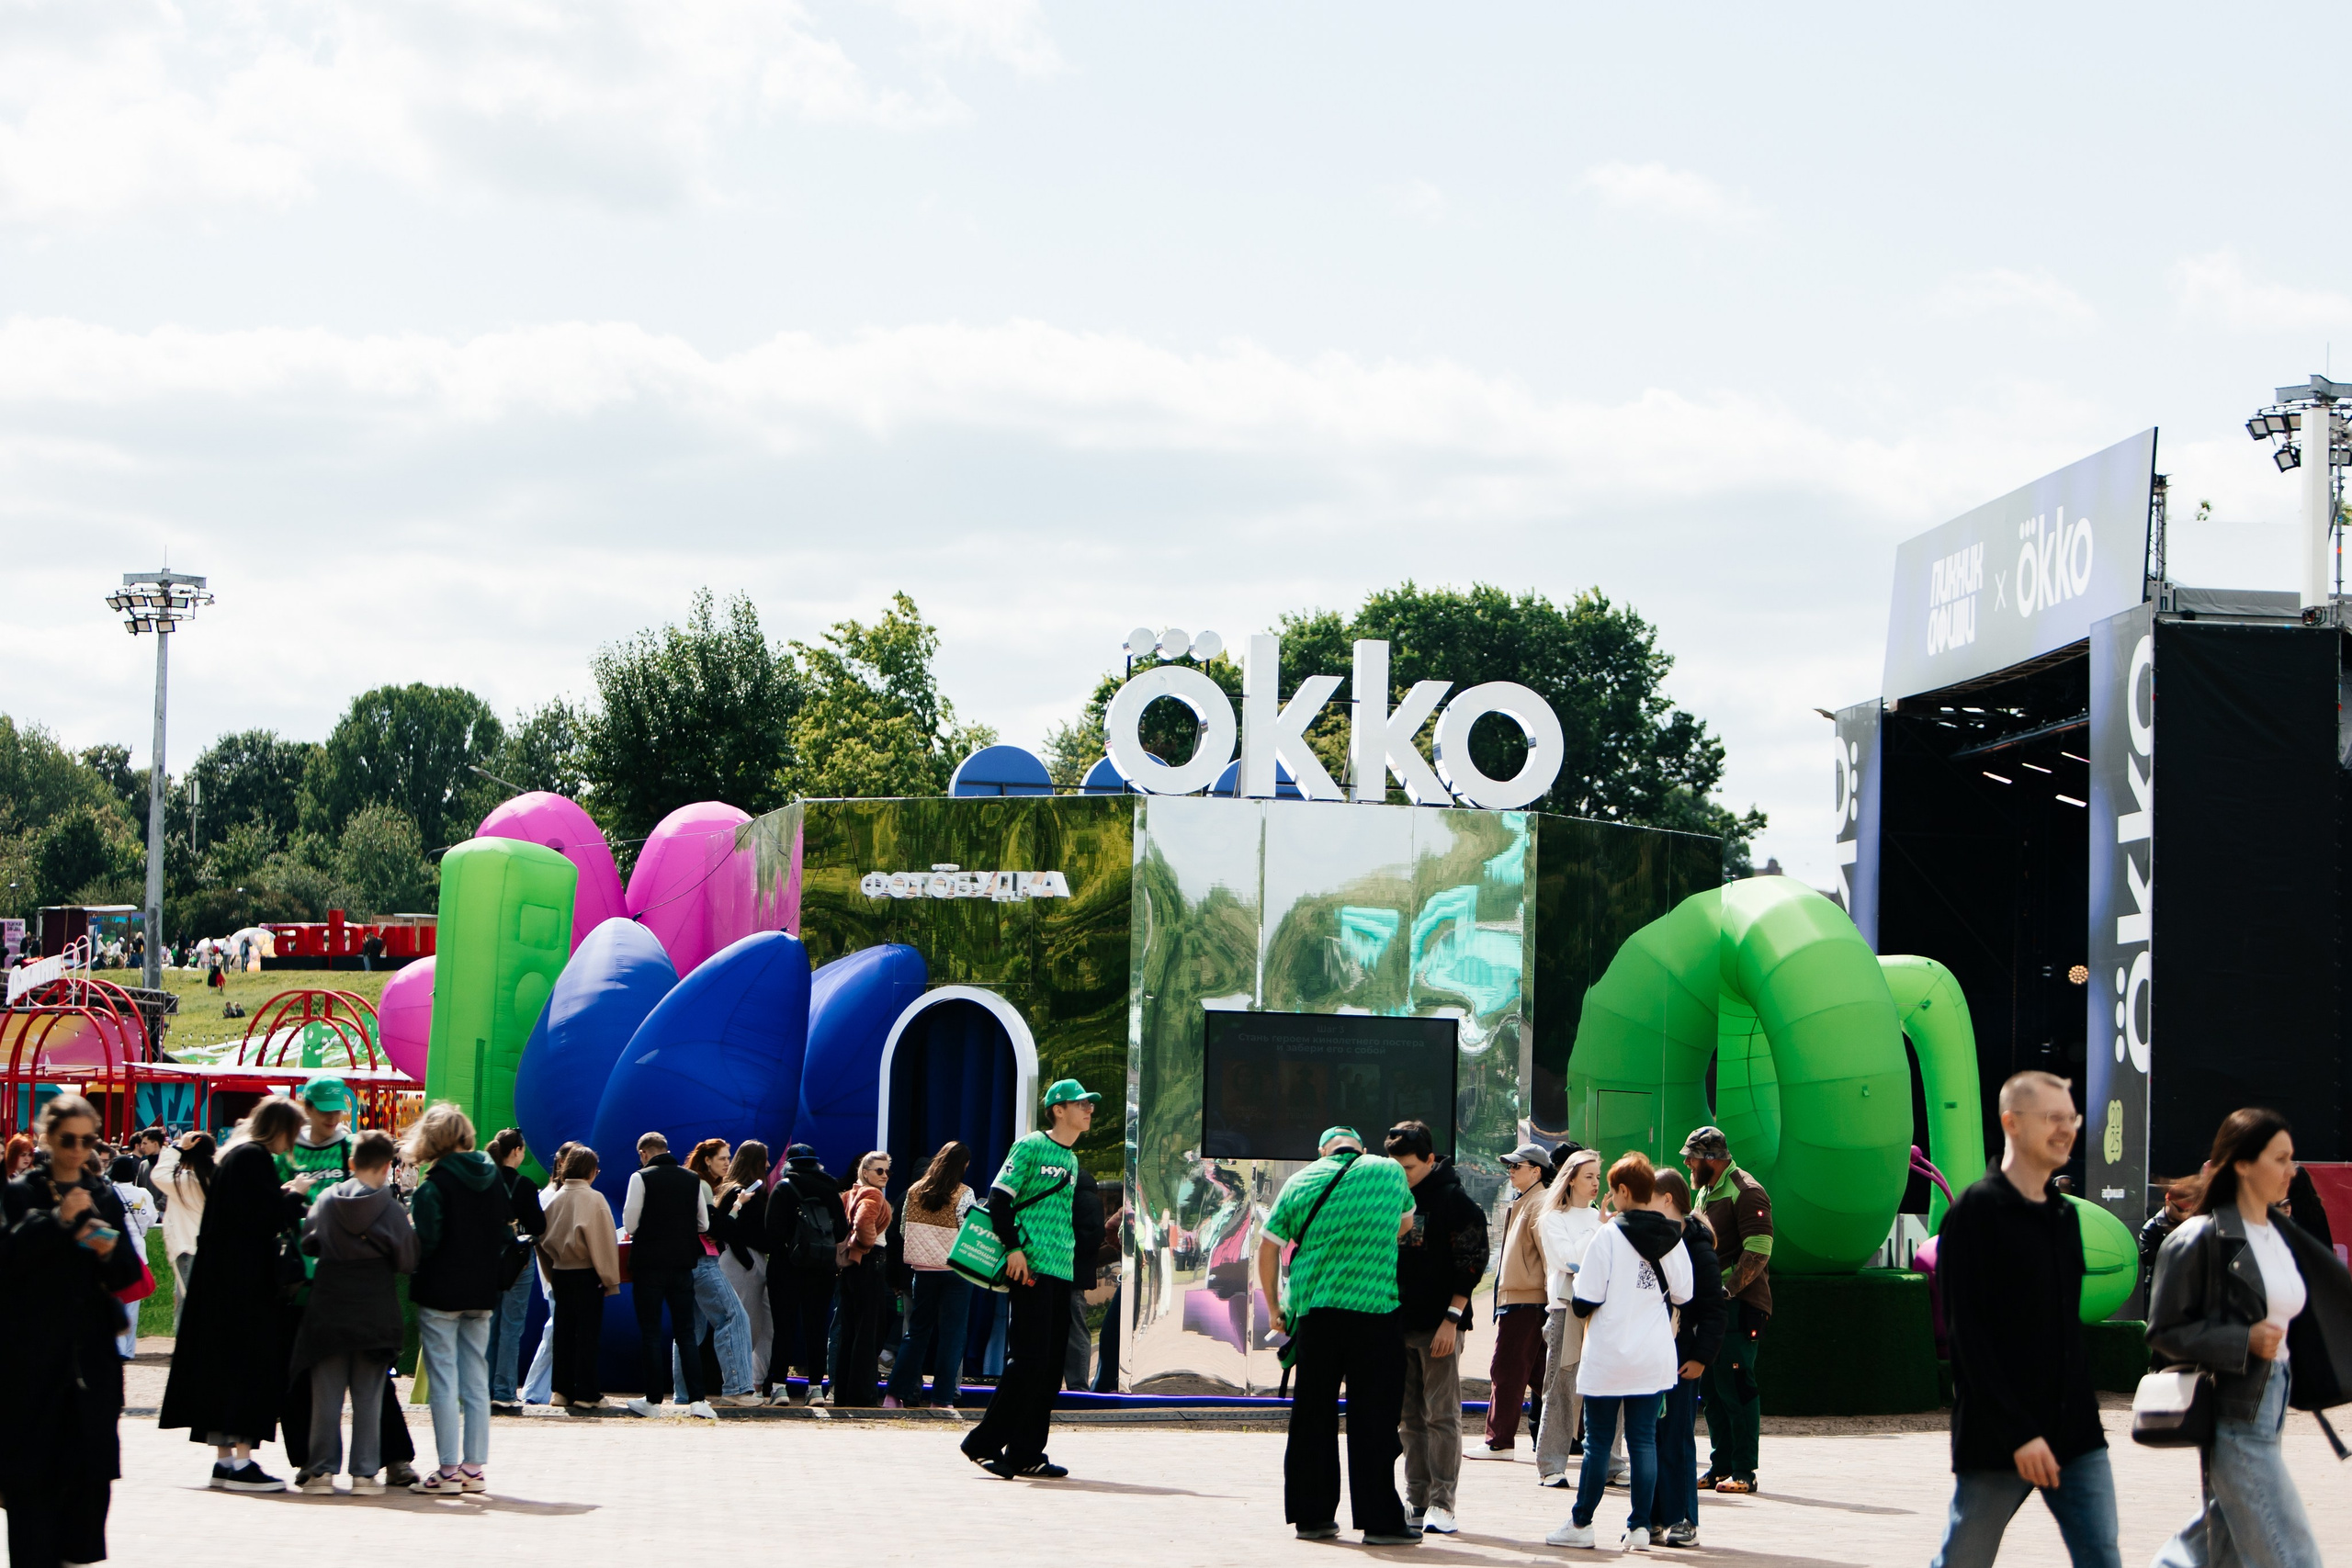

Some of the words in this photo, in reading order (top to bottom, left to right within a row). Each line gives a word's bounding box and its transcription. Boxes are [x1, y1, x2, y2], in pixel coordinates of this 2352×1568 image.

[1317, 1025, 1337, 1033] Шаг
[1340, 1025, 1345, 1033] 3
[1238, 1033, 1269, 1042] Стань
[1272, 1035, 1310, 1043] героем
[1314, 1037, 1380, 1045] кинолетнего
[1383, 1040, 1425, 1049] постера
[1286, 1043, 1324, 1055] забери
[1354, 1046, 1386, 1055] собой
[960, 1242, 1000, 1263] помощни
